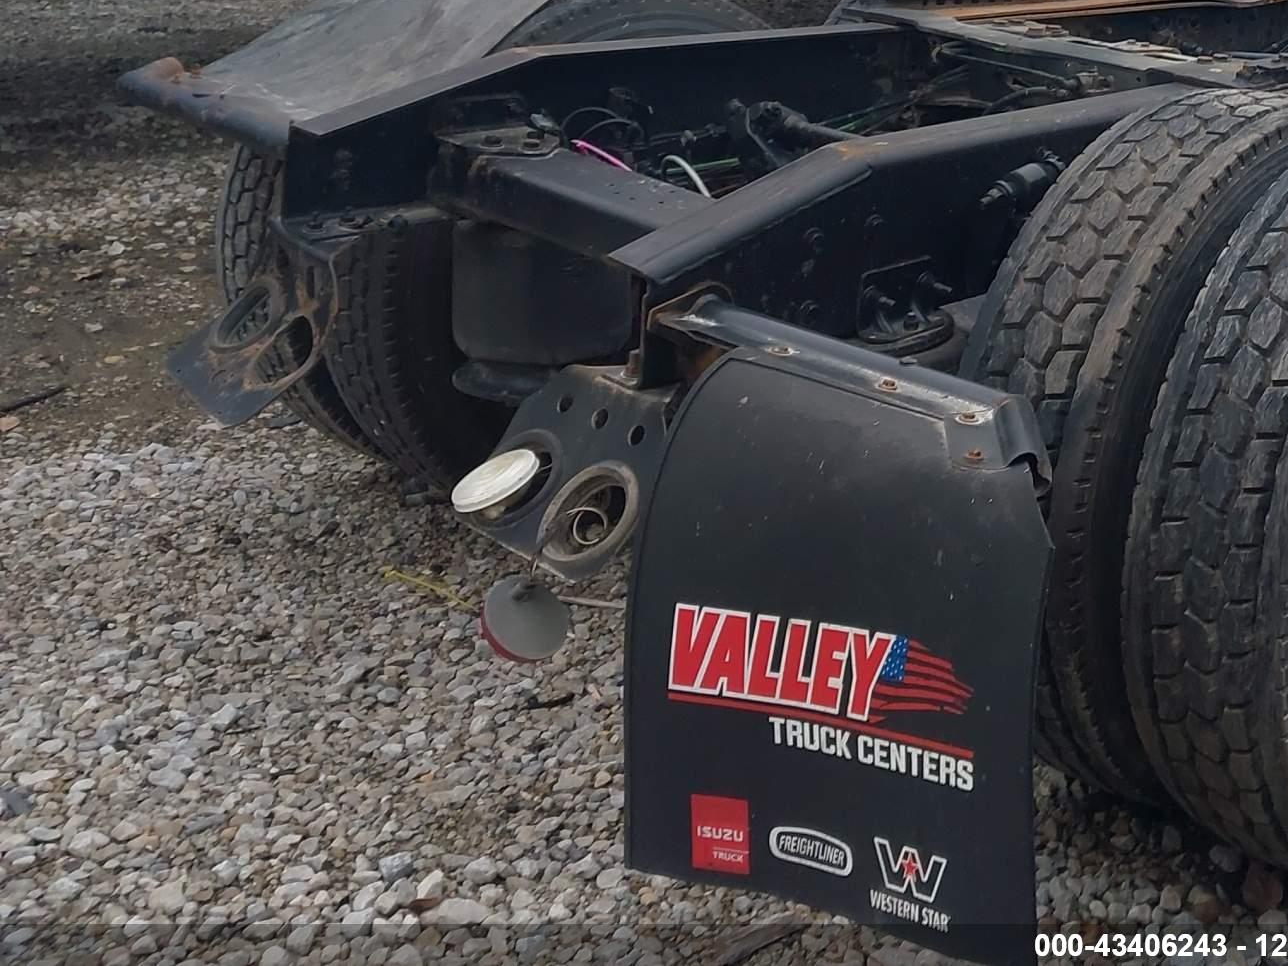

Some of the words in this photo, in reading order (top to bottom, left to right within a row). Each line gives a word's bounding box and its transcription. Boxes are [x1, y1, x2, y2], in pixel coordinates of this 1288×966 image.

[668, 603, 897, 721] VALLEY
[768, 716, 852, 760] TRUCK
[857, 735, 975, 792] CENTERS
[697, 826, 744, 843] ISUZU
[778, 834, 845, 867] FREIGHTLINER
[712, 850, 744, 863] TRUCK
[869, 889, 919, 922] WESTERN
[921, 906, 950, 933] STAR
